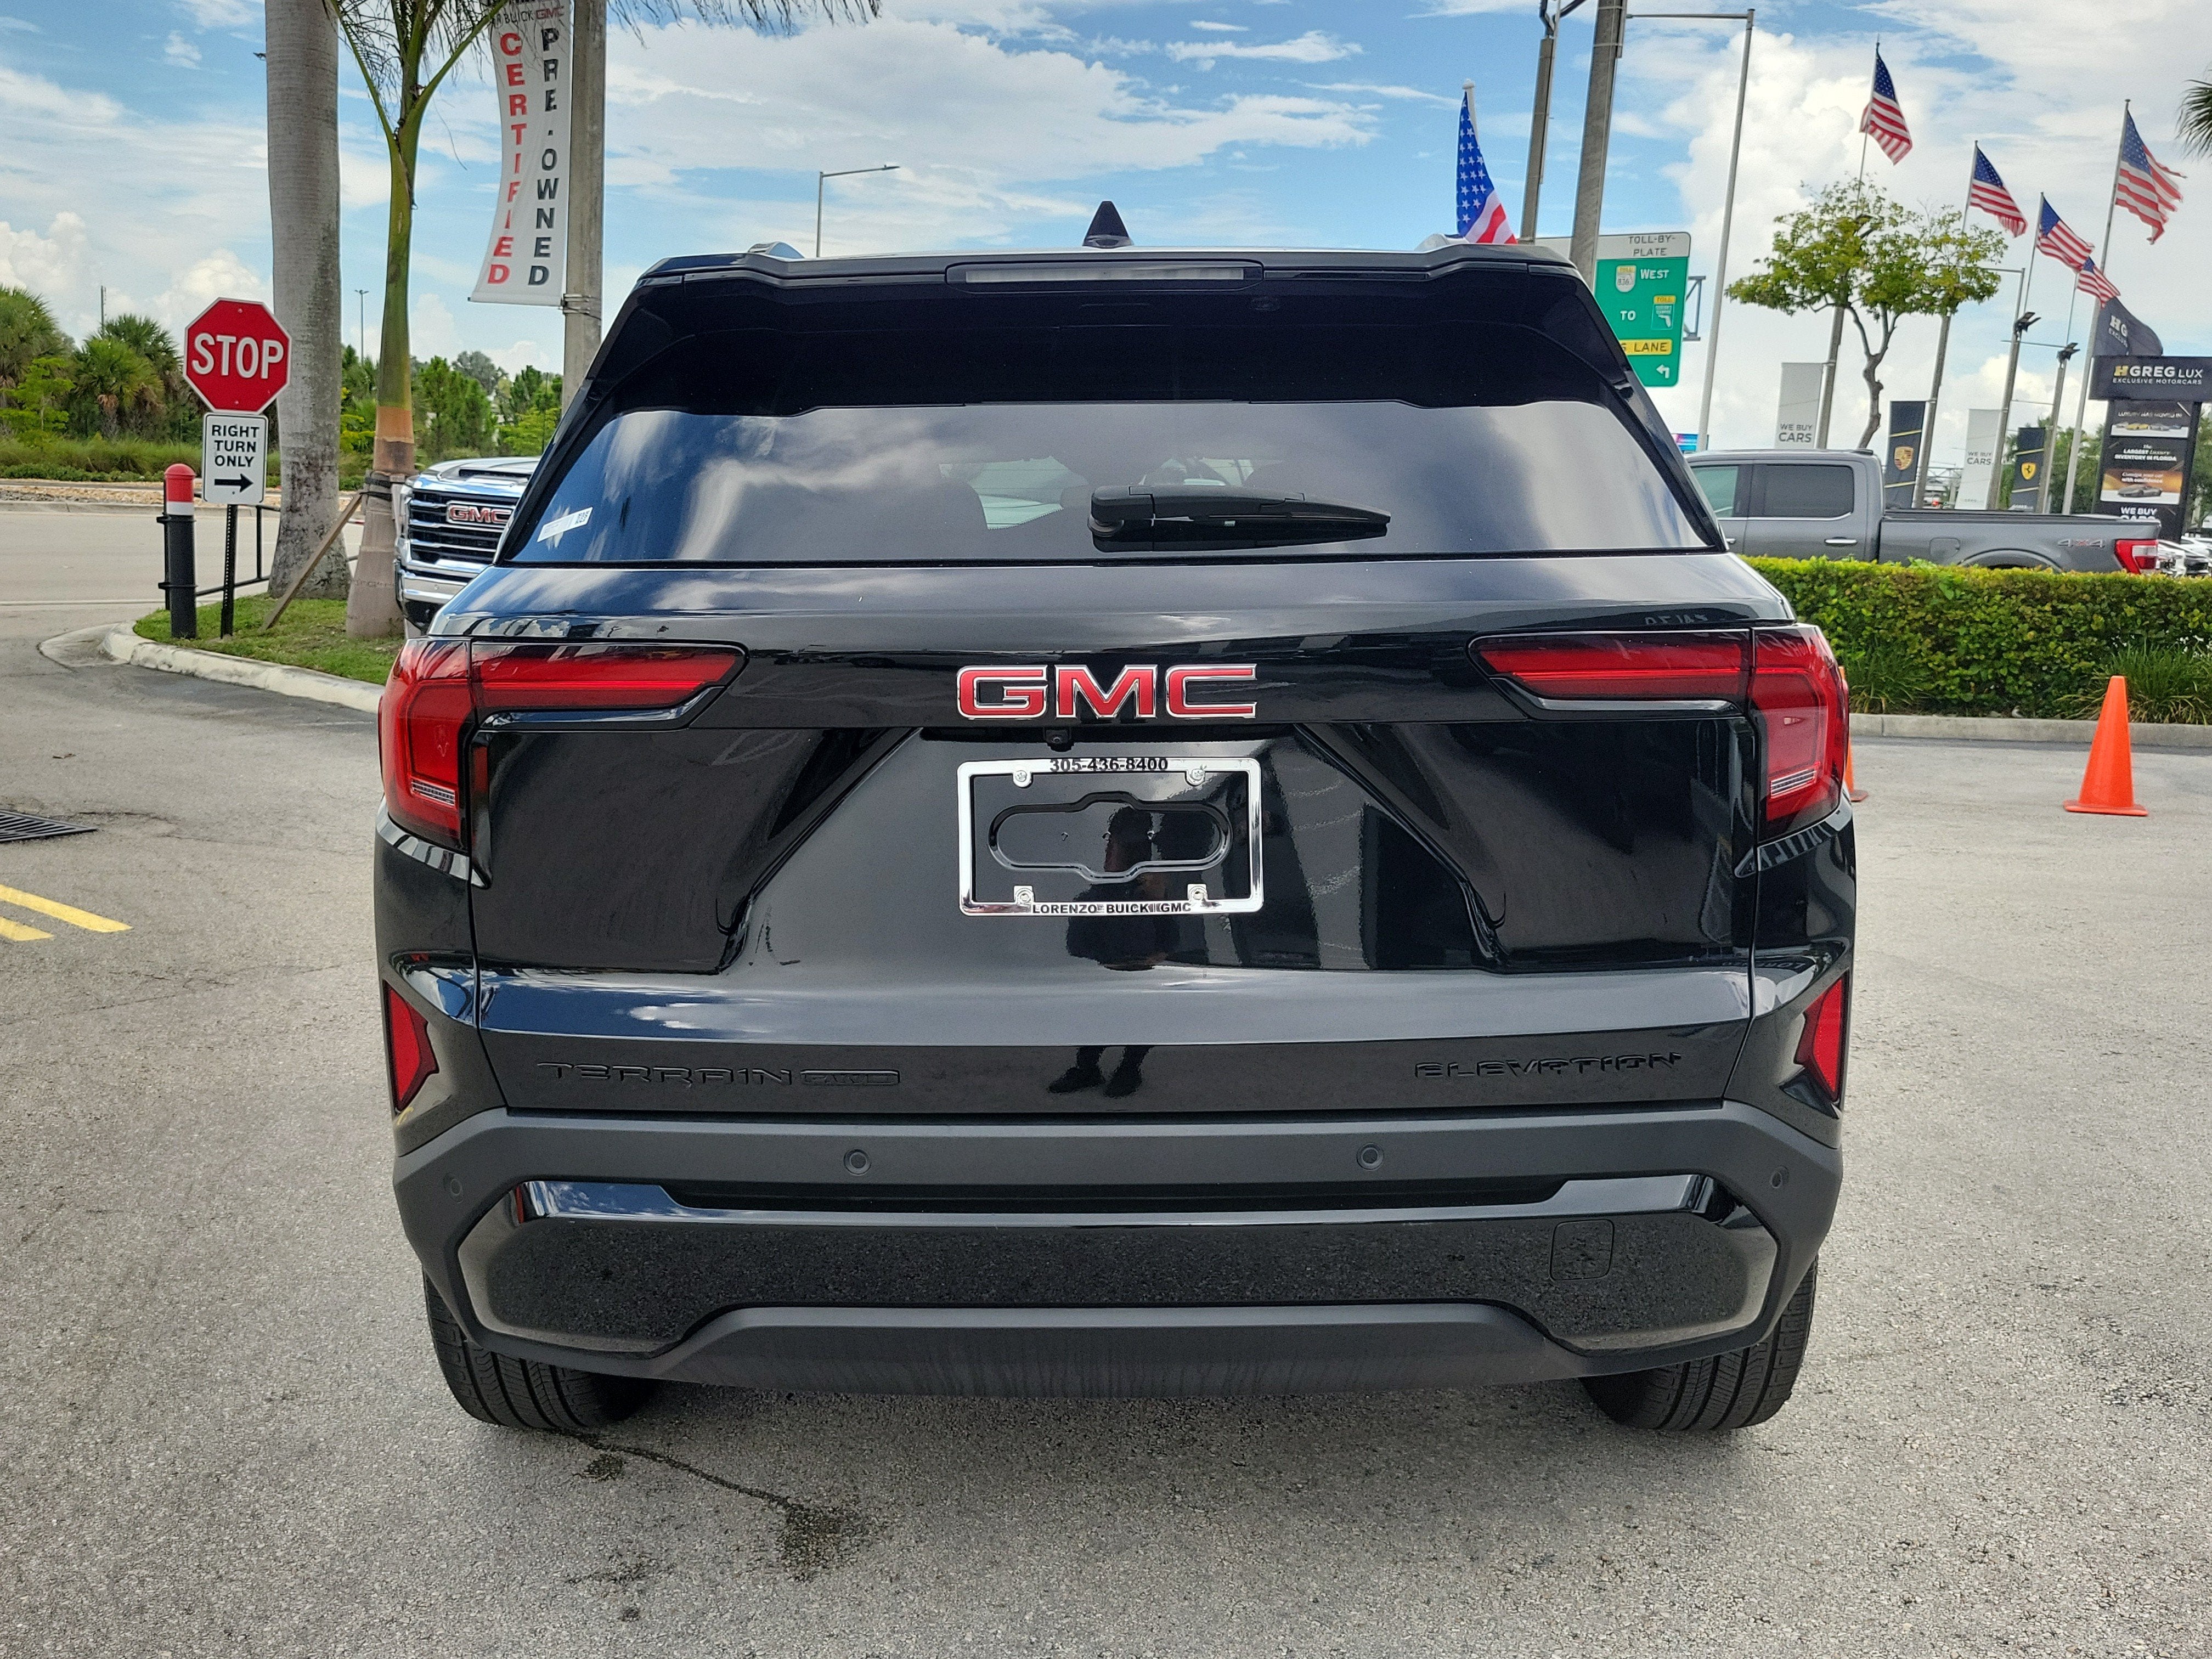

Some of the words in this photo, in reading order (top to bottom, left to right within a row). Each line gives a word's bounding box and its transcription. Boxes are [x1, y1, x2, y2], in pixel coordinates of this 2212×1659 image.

[487, 32, 527, 285] CERTIFIED
[1633, 247, 1667, 257] PLATE
[1640, 268, 1669, 279] WEST
[1620, 310, 1636, 321] TO
[1634, 342, 1668, 352] LANE
[191, 332, 284, 379] STOP
[2178, 369, 2203, 379] LUX
[212, 425, 260, 438] RIGHT
[1779, 432, 1813, 443] CARS
[215, 439, 257, 453] TURN
[215, 455, 255, 467] ONLY
[1967, 457, 1992, 465] CARS
[450, 505, 512, 523] GMC
[2120, 507, 2136, 515] WE
[956, 663, 1257, 719] GMC
[1049, 758, 1168, 772] 305-436-8400
[1032, 904, 1098, 914] LORENZO
[1106, 903, 1149, 913] BUICK
[1160, 902, 1191, 912] GMC
[1415, 1052, 1682, 1078] ELEVATION
[537, 1062, 792, 1088] TERRAIN
